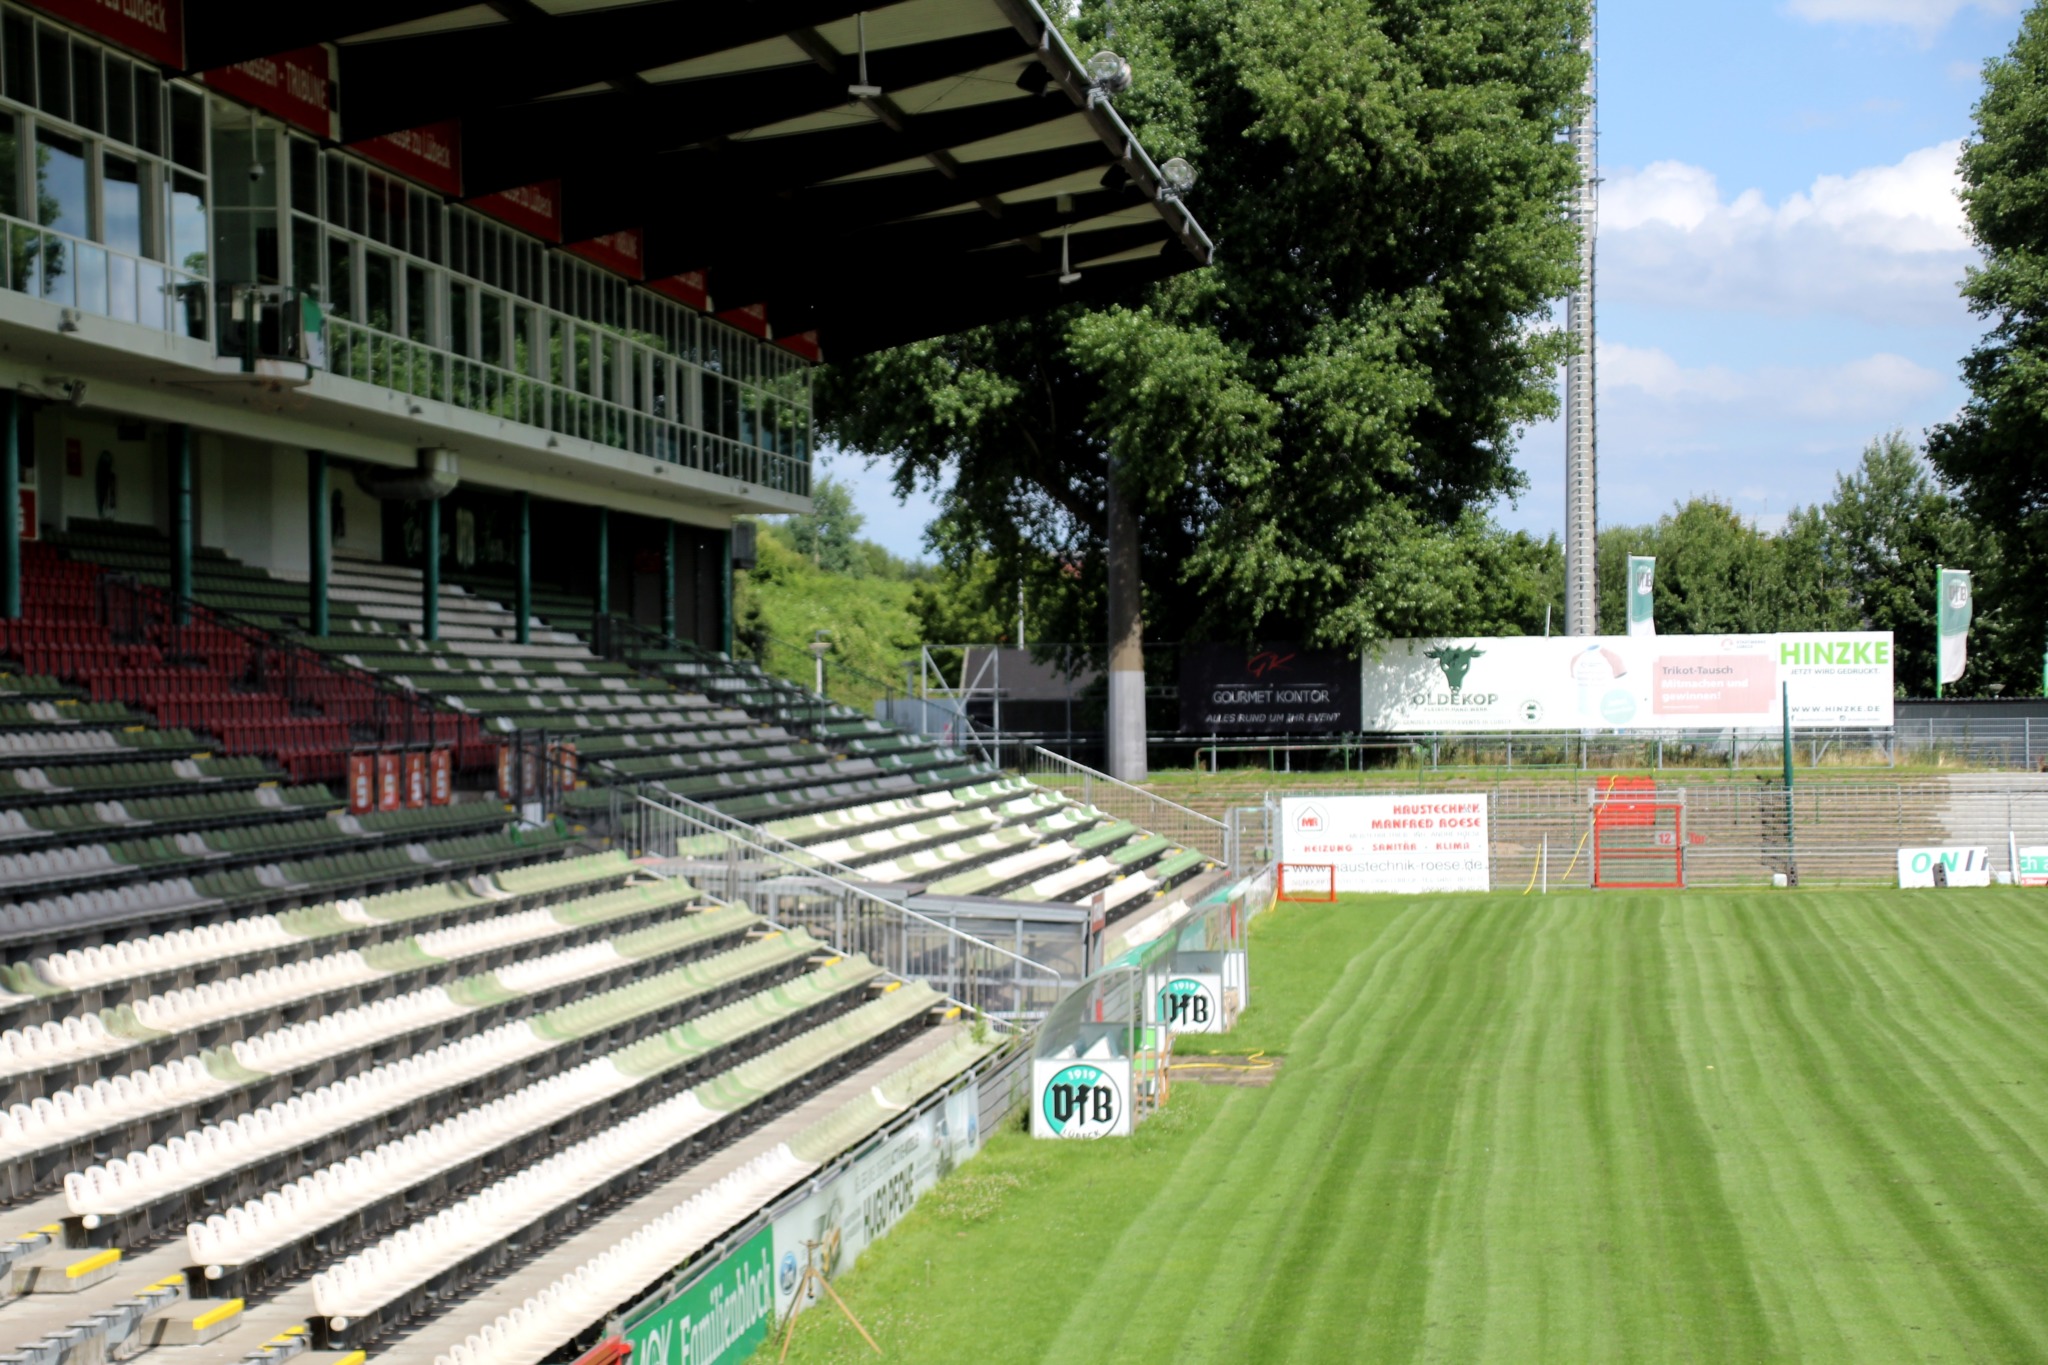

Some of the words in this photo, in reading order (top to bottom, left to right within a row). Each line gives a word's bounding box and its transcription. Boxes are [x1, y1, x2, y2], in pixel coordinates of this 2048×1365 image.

[1780, 641, 1889, 665] HINZKE
[1662, 666, 1733, 675] Trikot-Tausch
[1661, 679, 1724, 688] Mitmachen
[1727, 678, 1749, 688] und
[1212, 690, 1272, 703] GOURMET
[1276, 689, 1330, 703] KONTOR
[1413, 693, 1499, 706] OLDEKOP
[1662, 691, 1721, 702] gewinnen!
[1205, 713, 1236, 723] ALLES
[1237, 713, 1267, 722] RUND
[1270, 713, 1284, 722] UM
[1307, 712, 1341, 722] EVENT
[1393, 803, 1481, 815] HAUSTECHNIK
[1371, 818, 1434, 829] MANFRED
[1439, 817, 1481, 828] ROESE
[1658, 833, 1671, 844] 12
[1688, 832, 1707, 845] Tor
[1372, 842, 1418, 851] SANITÄR
[1435, 842, 1470, 850] KLIMA
[1173, 982, 1196, 991] 1919
[1161, 992, 1208, 1026] VfB
[1067, 1069, 1096, 1081] 1919
[1052, 1083, 1113, 1127] VfB
